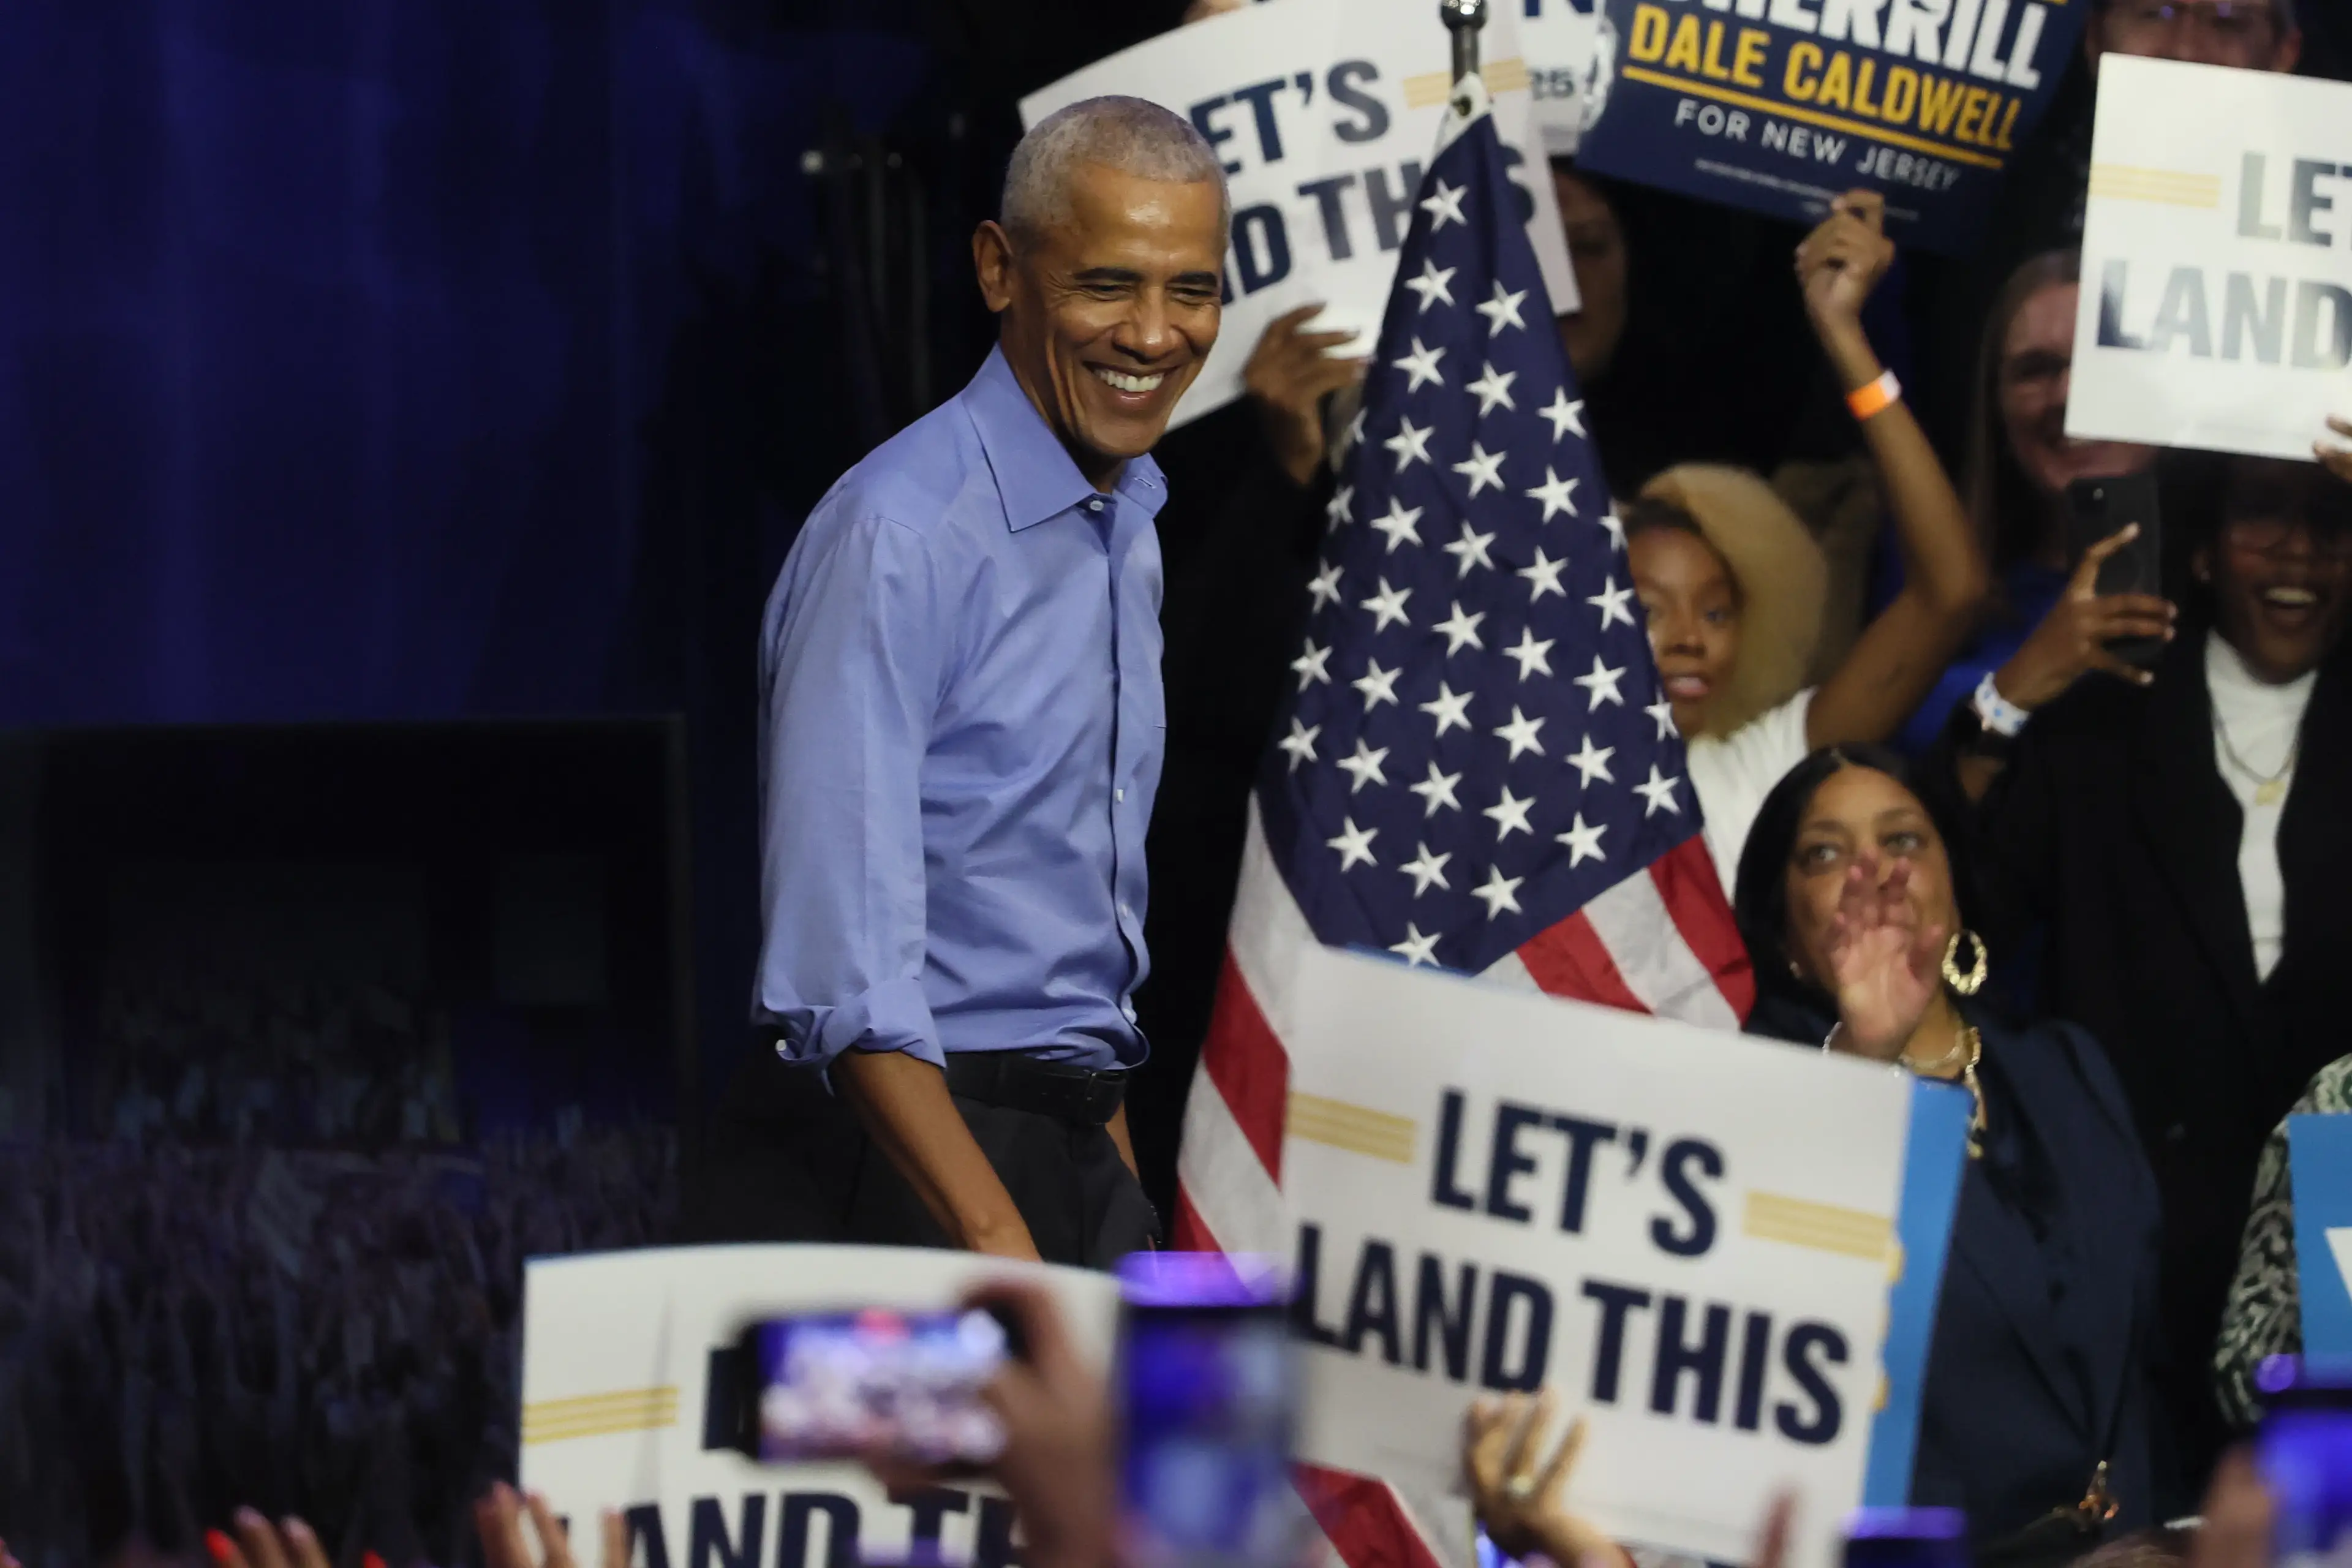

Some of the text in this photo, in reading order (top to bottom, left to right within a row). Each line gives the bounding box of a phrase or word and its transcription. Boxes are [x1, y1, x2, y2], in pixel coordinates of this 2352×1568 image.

[1629, 4, 2021, 151] DALE CALDWELL
[1669, 0, 2041, 89] RRILL
[1189, 60, 1390, 174] ET'S
[1675, 98, 1751, 142] FOR
[1762, 121, 1846, 165] NEW
[1855, 146, 1960, 191] JERSEY
[2238, 153, 2352, 248] LE
[2097, 260, 2352, 368] LAND
[1430, 1087, 1725, 1257] LET'S
[1291, 1222, 1850, 1447] LAND THIS
[559, 1492, 862, 1568] AND
